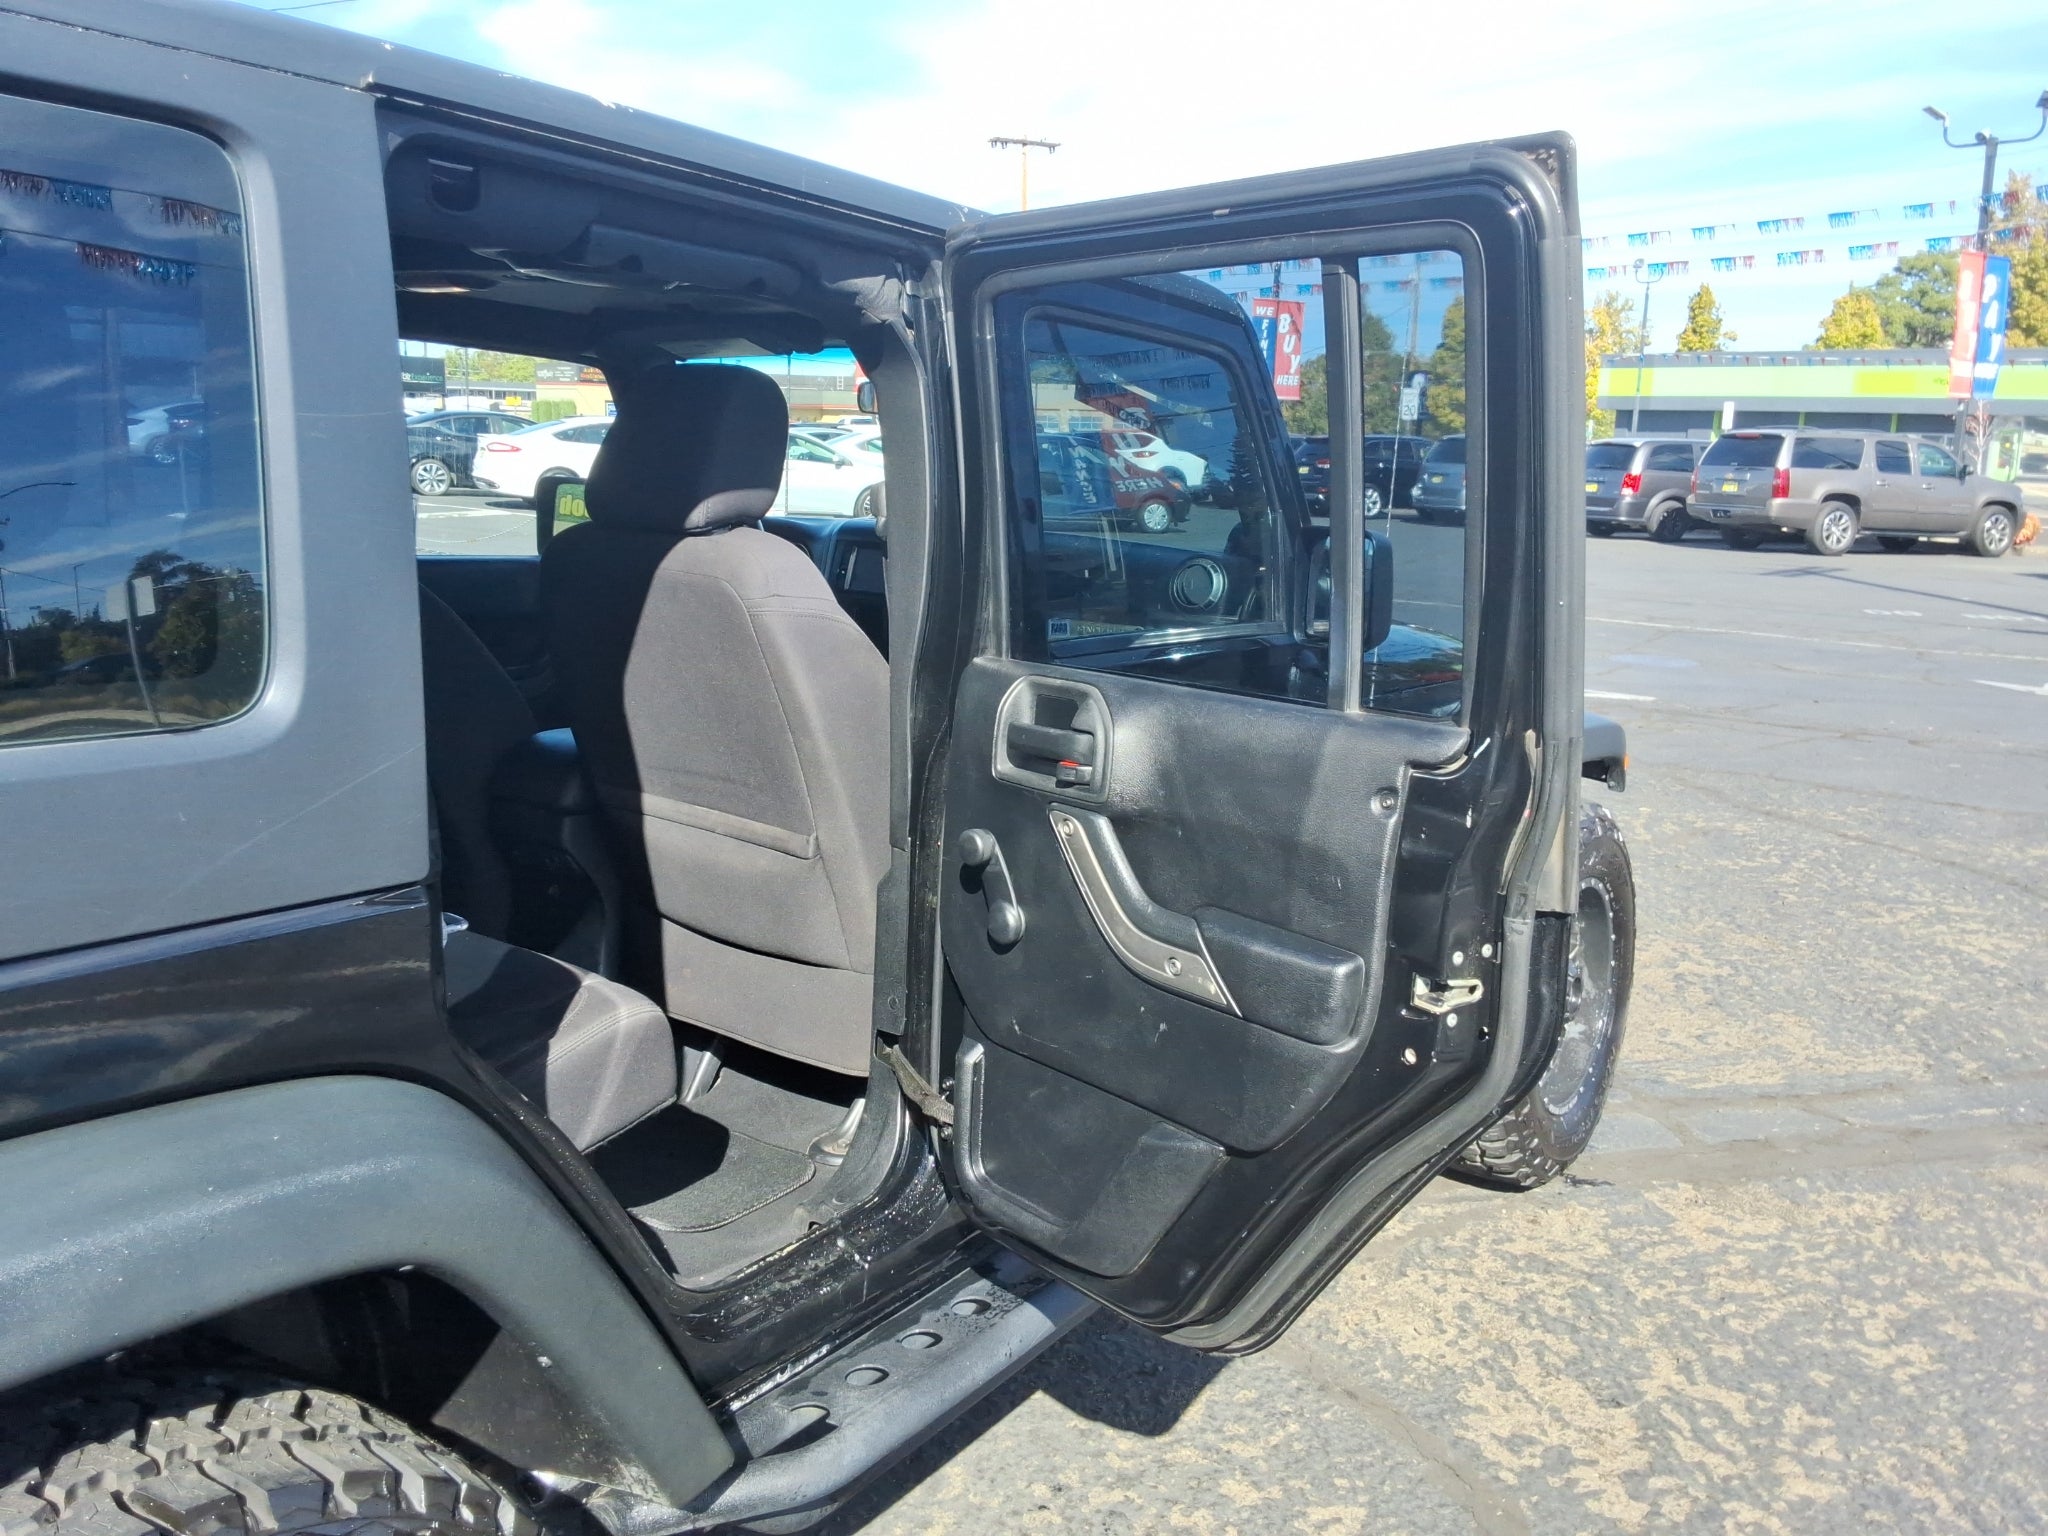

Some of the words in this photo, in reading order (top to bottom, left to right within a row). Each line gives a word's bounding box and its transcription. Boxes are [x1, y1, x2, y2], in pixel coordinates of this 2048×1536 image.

[1255, 306, 1275, 317] WE
[1278, 313, 1301, 375] BUY
[1276, 374, 1300, 386] HERE
[1403, 405, 1416, 417] 20
